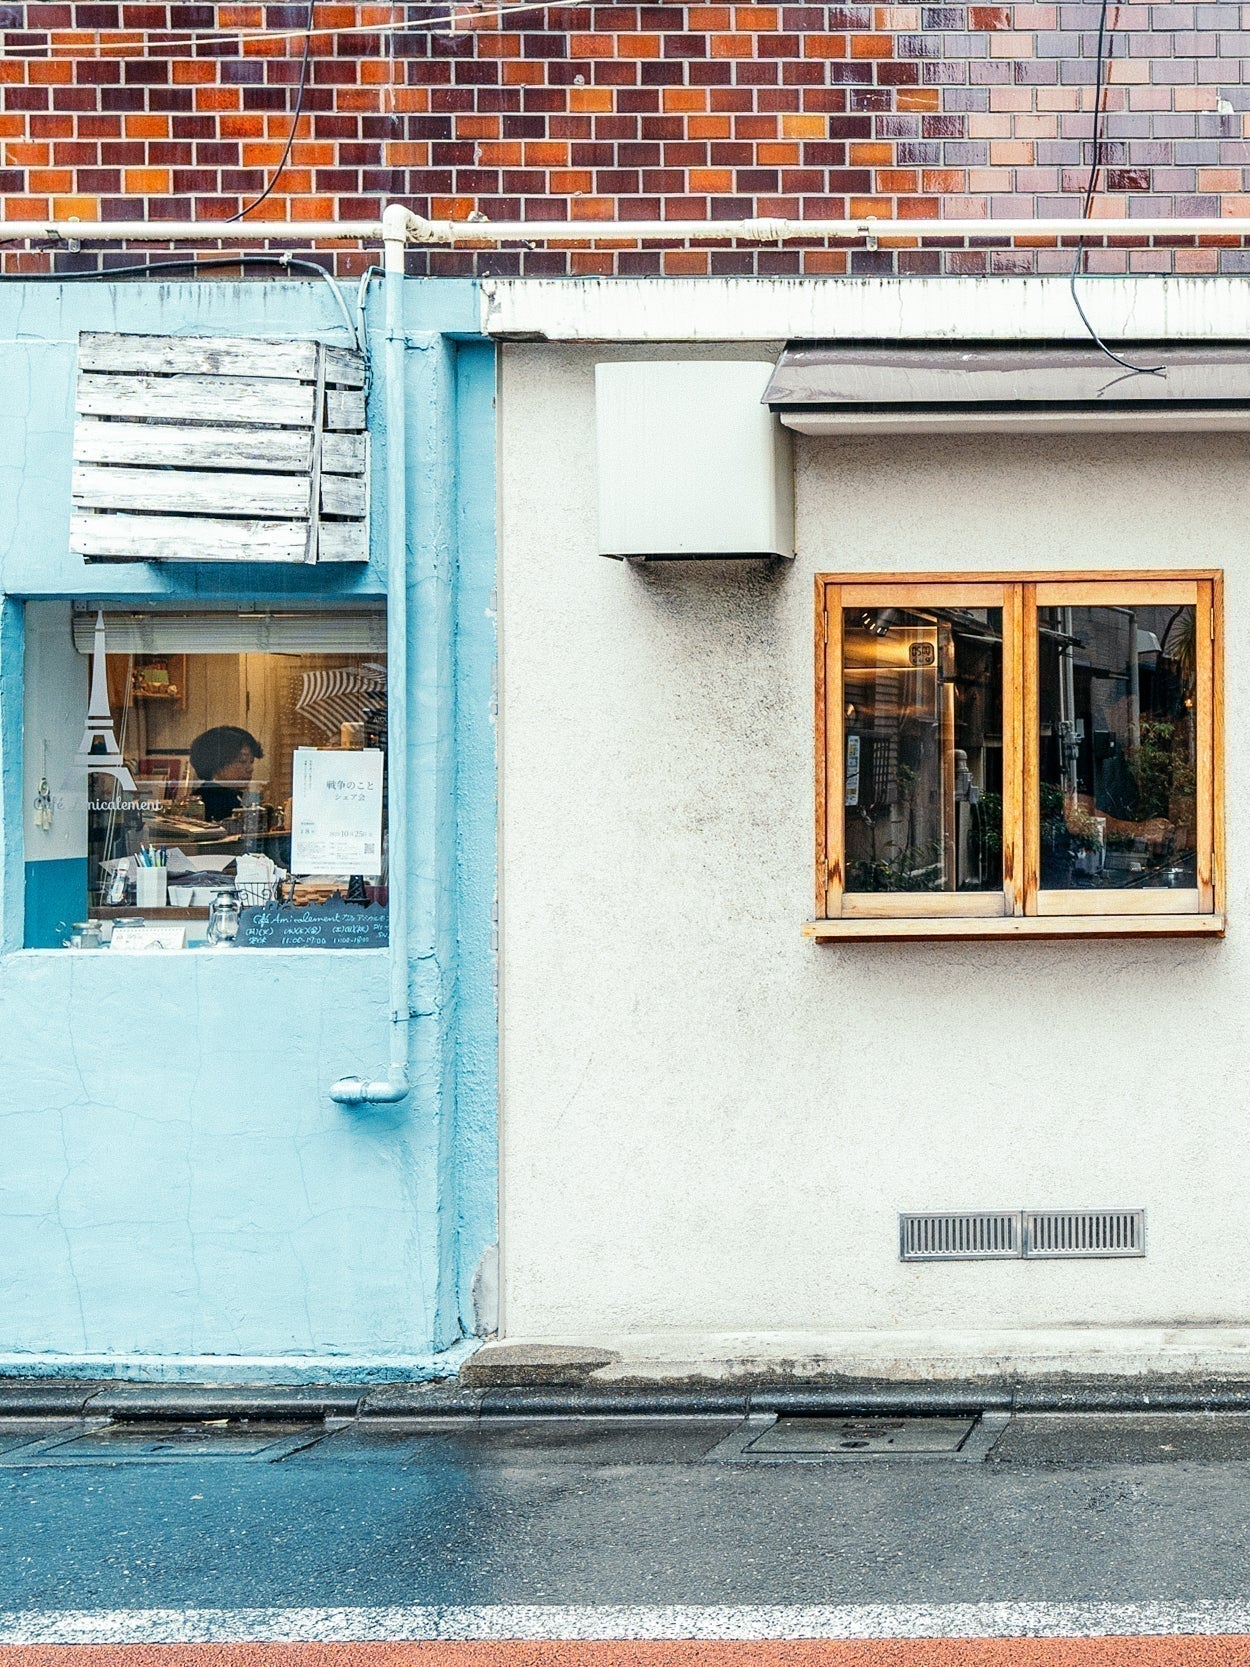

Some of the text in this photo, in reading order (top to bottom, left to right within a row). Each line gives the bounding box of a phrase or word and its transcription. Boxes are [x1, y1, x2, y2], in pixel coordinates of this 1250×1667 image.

[326, 780, 375, 791] 戦争のこと
[335, 793, 366, 801] シェア会
